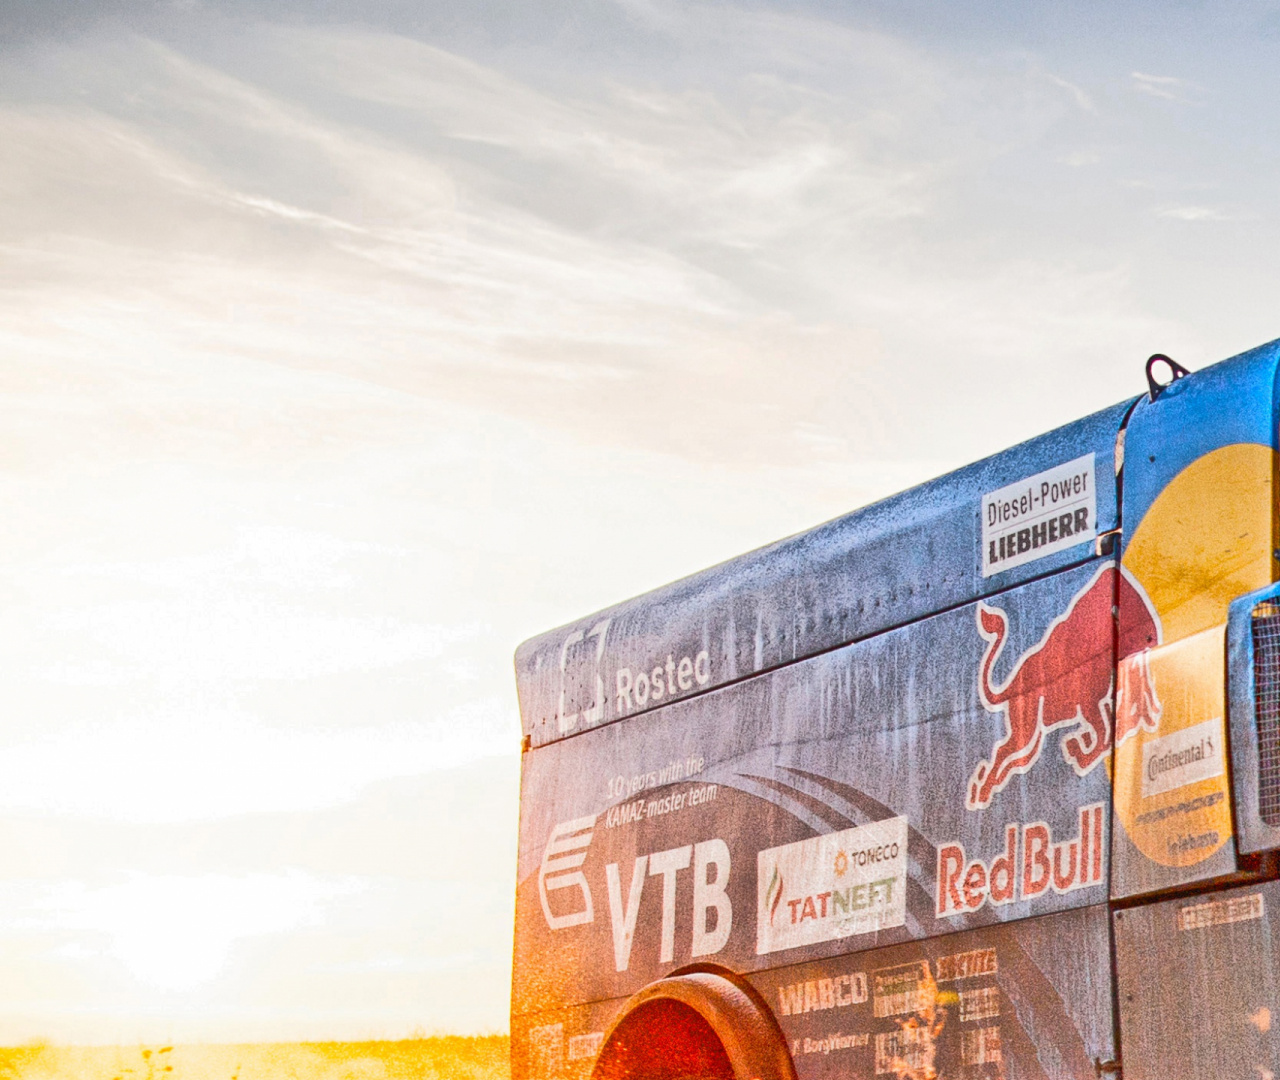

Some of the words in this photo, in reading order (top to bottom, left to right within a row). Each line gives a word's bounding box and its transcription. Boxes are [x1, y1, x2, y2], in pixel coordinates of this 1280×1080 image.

[987, 470, 1088, 527] Diesel-Power
[988, 506, 1089, 564] LIEBHERR
[616, 650, 709, 712] Rostec
[607, 775, 624, 800] 10
[659, 761, 685, 785] with
[686, 755, 705, 775] the
[1147, 738, 1205, 781] Continental
[688, 783, 718, 808] team
[605, 838, 733, 973] VTB
[787, 876, 898, 925] TATNEFT
[779, 972, 868, 1016] WABCO
